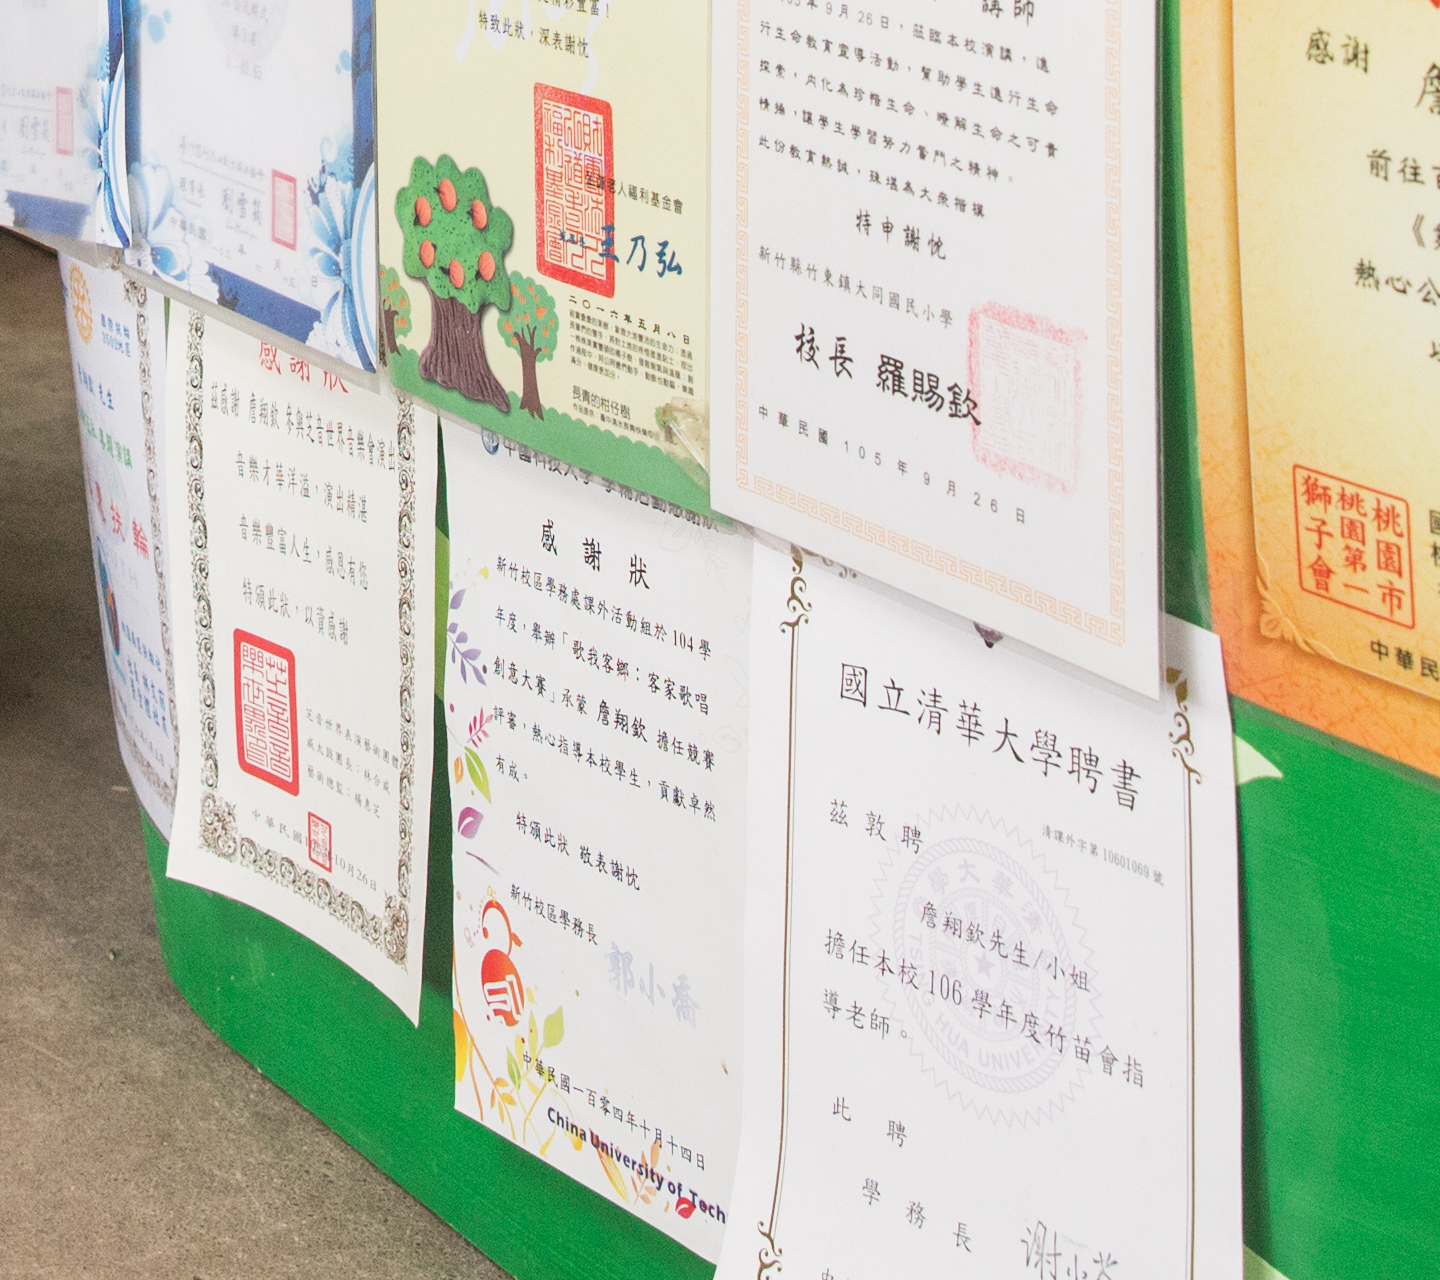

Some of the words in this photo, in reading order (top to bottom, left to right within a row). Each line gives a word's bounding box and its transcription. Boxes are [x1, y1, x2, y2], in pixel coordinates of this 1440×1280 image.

[1304, 28, 1371, 73] 感謝
[855, 207, 947, 262] 特申謝忱
[757, 244, 953, 329] 新竹縣竹東鎮大同國民小學
[794, 322, 855, 380] 校長
[876, 353, 982, 427] 羅賜欽
[540, 519, 650, 590] 感謝狀
[1299, 473, 1336, 597] 獅子會
[1337, 485, 1370, 599] 桃園第一
[1371, 495, 1407, 623] 桃園市
[672, 629, 694, 653] 104
[597, 699, 648, 744] 詹翔欽
[656, 728, 715, 773] 擔任競賽
[839, 662, 1142, 812] 國立清華大學聘書
[515, 810, 571, 858] 特頒此狀
[579, 844, 641, 893] 敬表謝忱
[829, 798, 924, 855] 茲敦聘
[509, 883, 599, 947] 新竹校區學務長
[920, 901, 1091, 994] 詹翔欽先生/小姐
[824, 929, 920, 991] 擔任本校
[929, 969, 963, 1007] 106
[971, 987, 1145, 1089] 學年度竹苗會指
[547, 1105, 588, 1143] China
[590, 1127, 665, 1193] University
[666, 1180, 685, 1199] of
[832, 1096, 908, 1149] 此聘
[862, 1177, 973, 1253] 學務長
